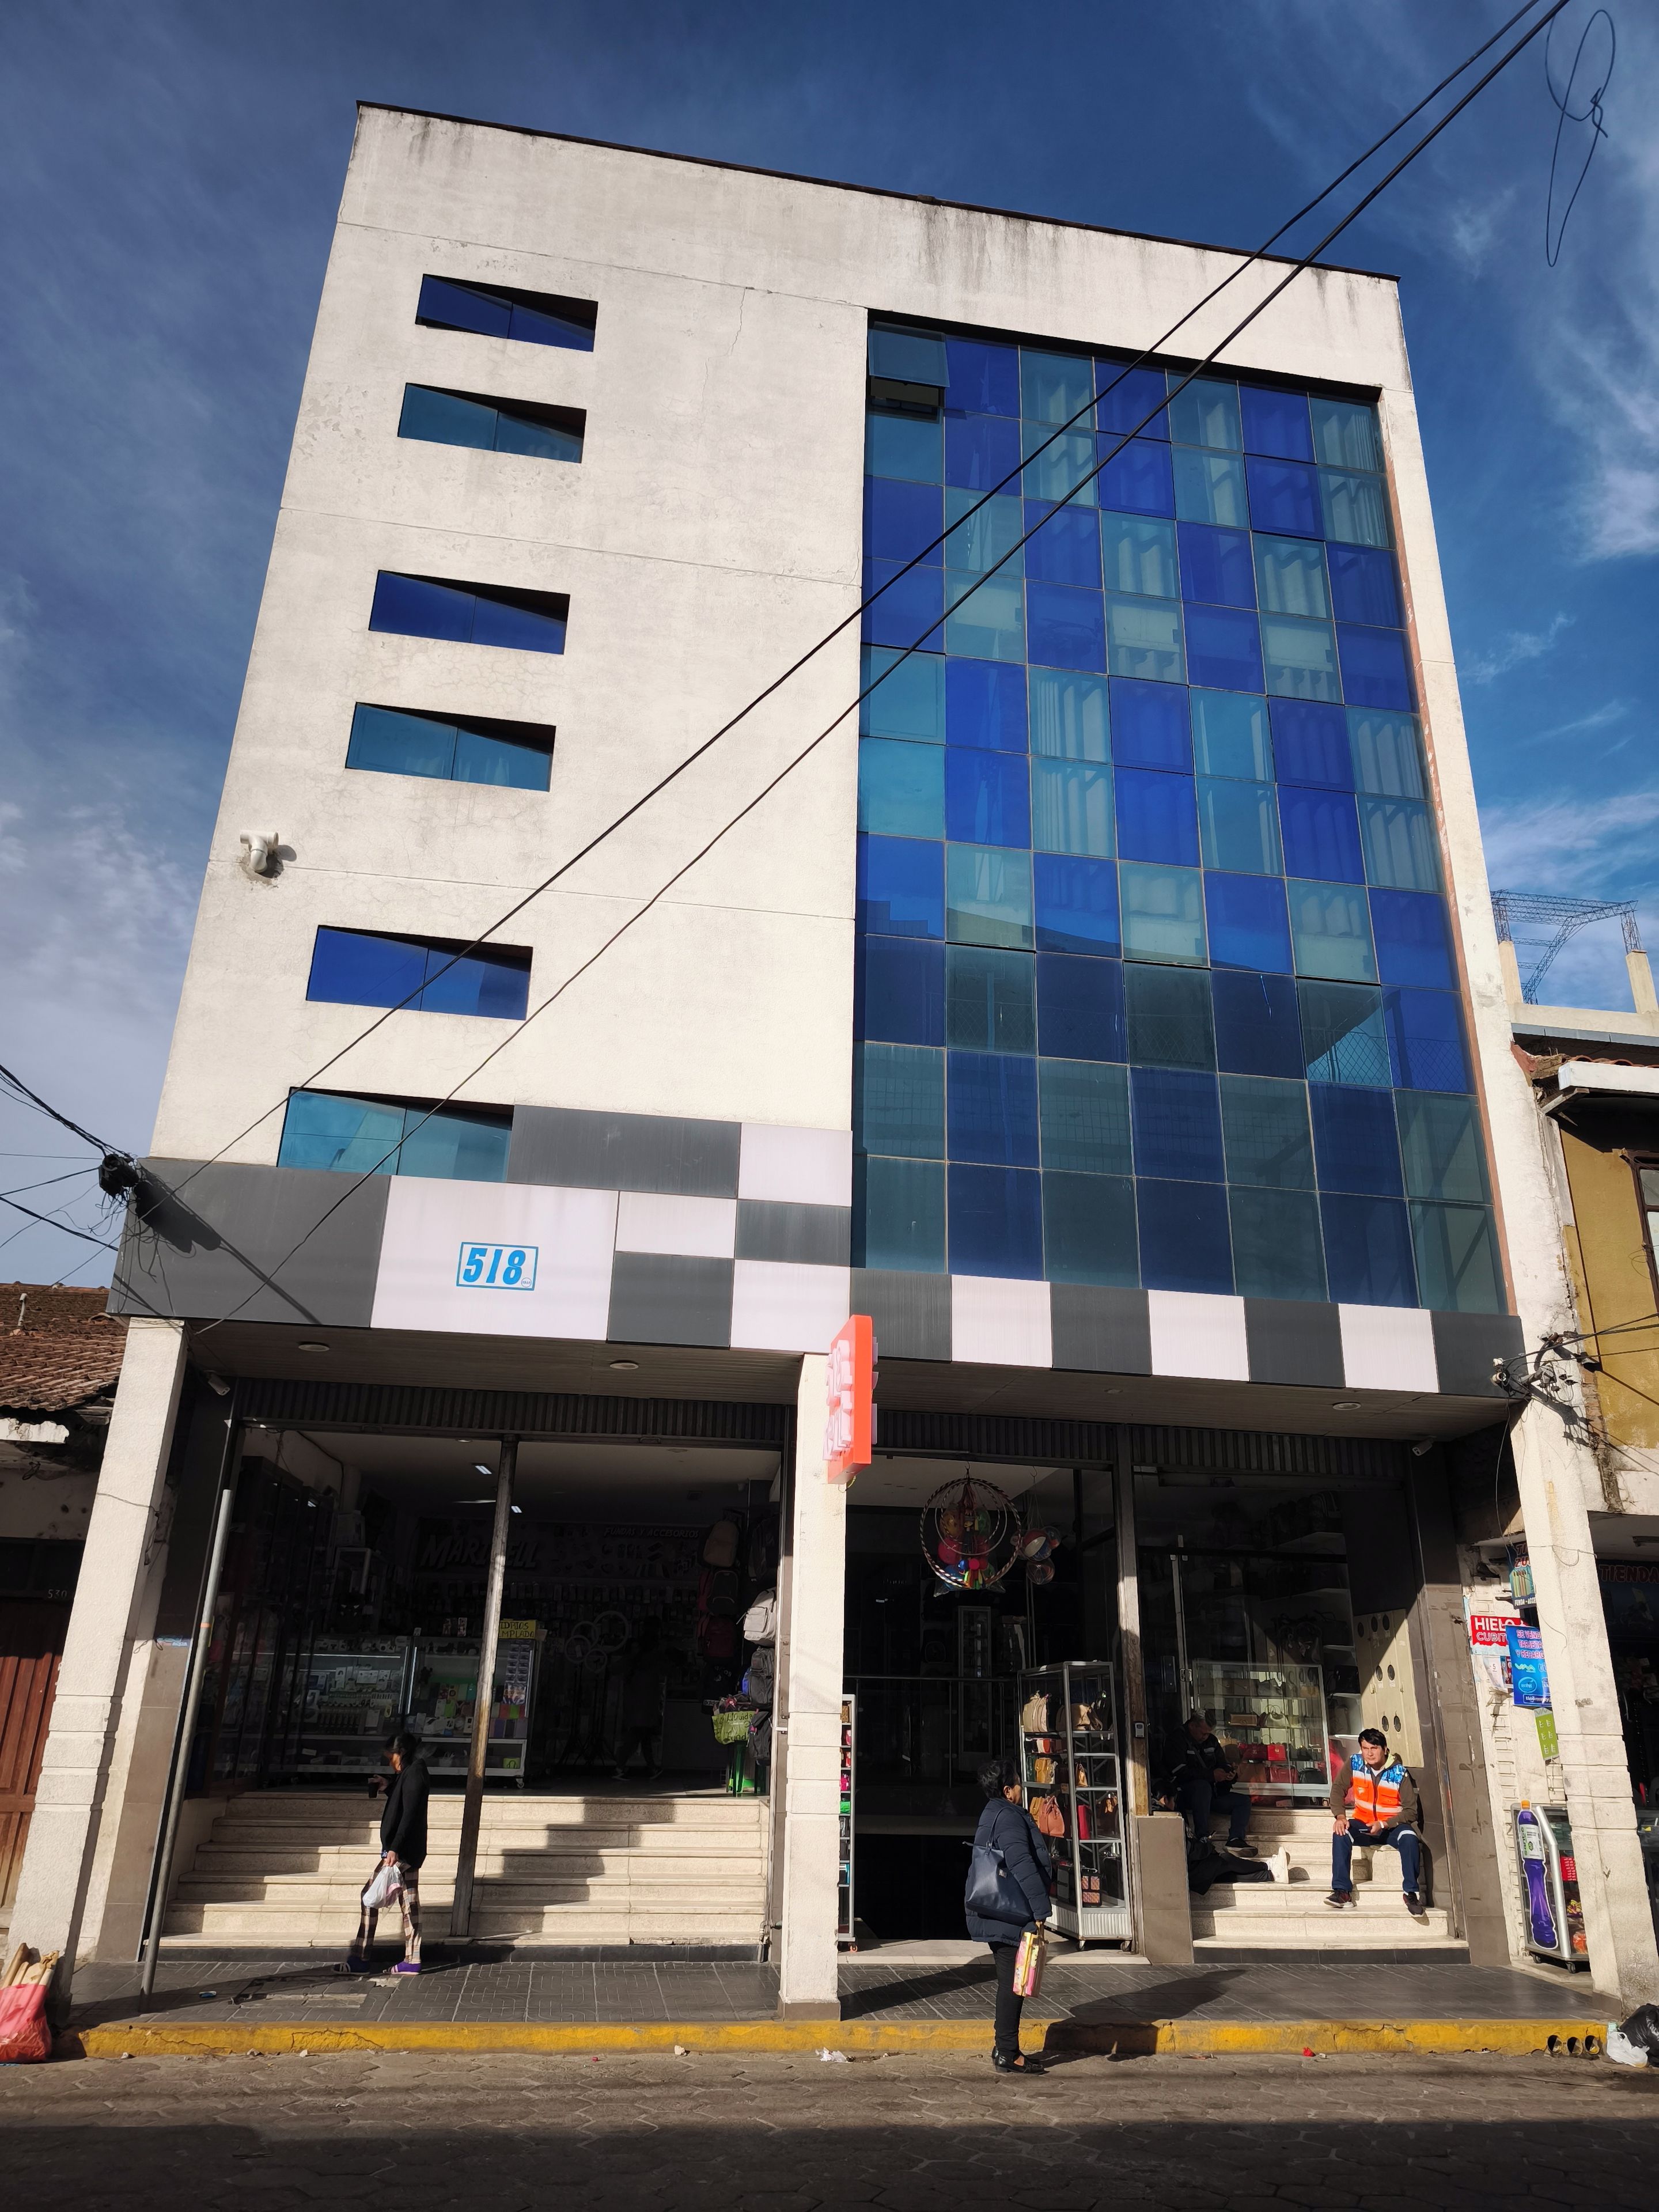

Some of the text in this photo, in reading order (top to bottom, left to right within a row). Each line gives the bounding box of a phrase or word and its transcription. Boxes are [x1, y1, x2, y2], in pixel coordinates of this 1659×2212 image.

[463, 1247, 526, 1285] 518
[419, 1535, 539, 1568] MARIELL
[47, 1589, 67, 1599] 530
[501, 1622, 529, 1630] IDRIOS
[1476, 1632, 1506, 1642] CUBIT
